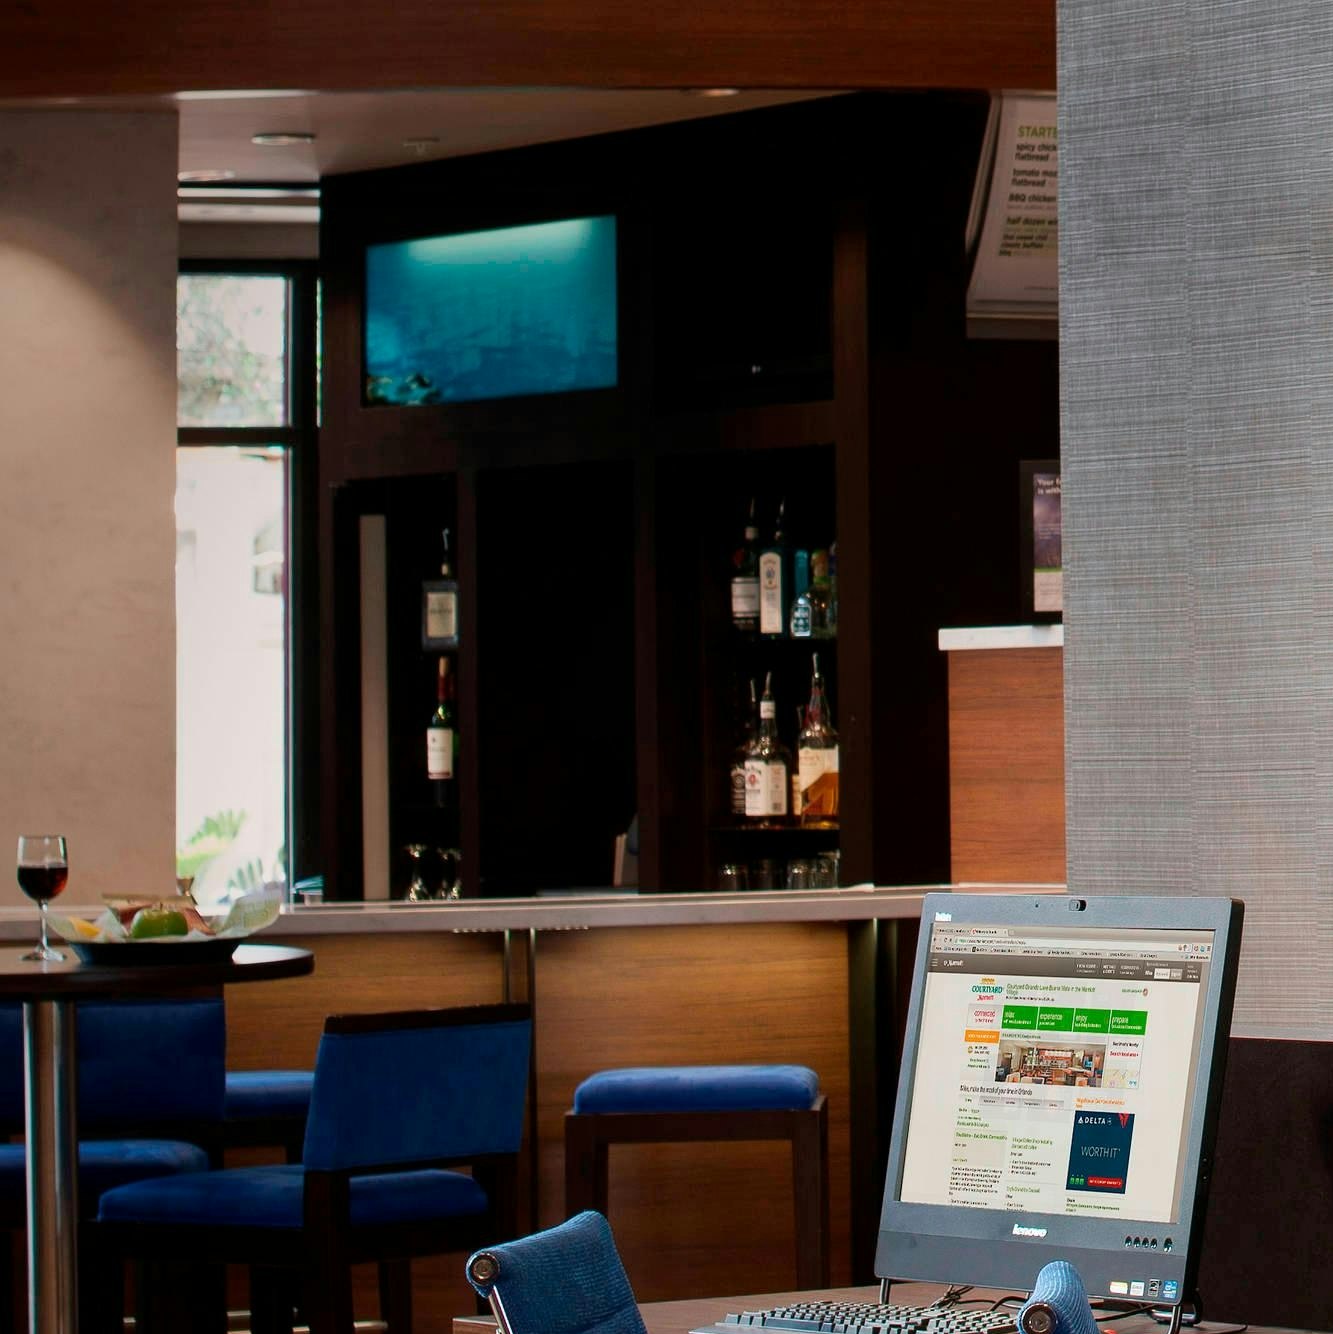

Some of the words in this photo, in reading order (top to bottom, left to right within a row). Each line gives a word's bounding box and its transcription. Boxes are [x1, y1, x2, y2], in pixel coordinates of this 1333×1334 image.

[1014, 152, 1049, 161] flatbread
[1012, 168, 1040, 177] tomato
[1011, 177, 1046, 187] flatbread
[1008, 193, 1026, 202] BBQ
[972, 985, 1003, 993] COURTYARD
[1085, 1116, 1105, 1124] DELTA
[1081, 1146, 1110, 1157] WORTH
[1012, 1224, 1048, 1238] lenovo
